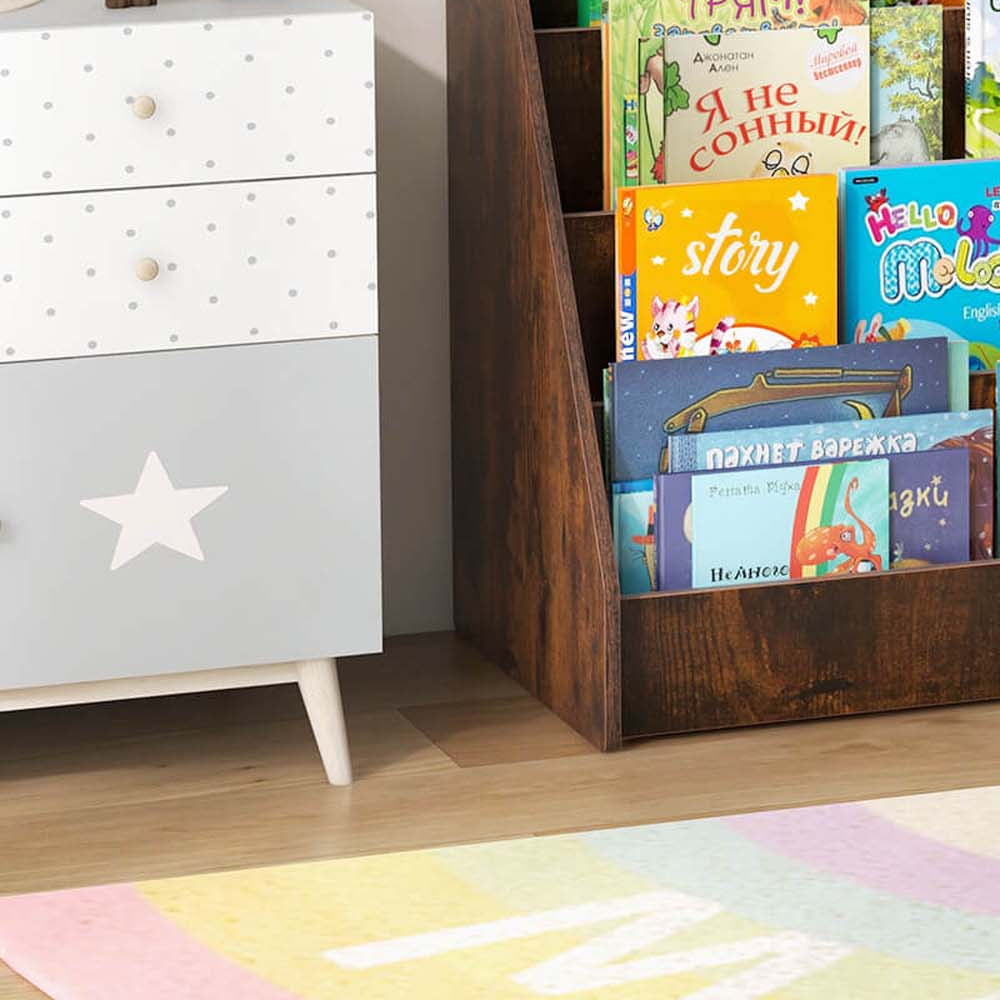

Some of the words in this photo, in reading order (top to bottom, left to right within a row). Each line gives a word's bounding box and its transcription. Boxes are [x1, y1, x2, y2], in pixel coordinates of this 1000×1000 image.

[693, 51, 754, 63] Джонатан
[695, 86, 732, 134] Я
[743, 82, 798, 113] не
[689, 110, 867, 172] сонный!
[867, 203, 956, 243] HELLO
[681, 211, 799, 293] story
